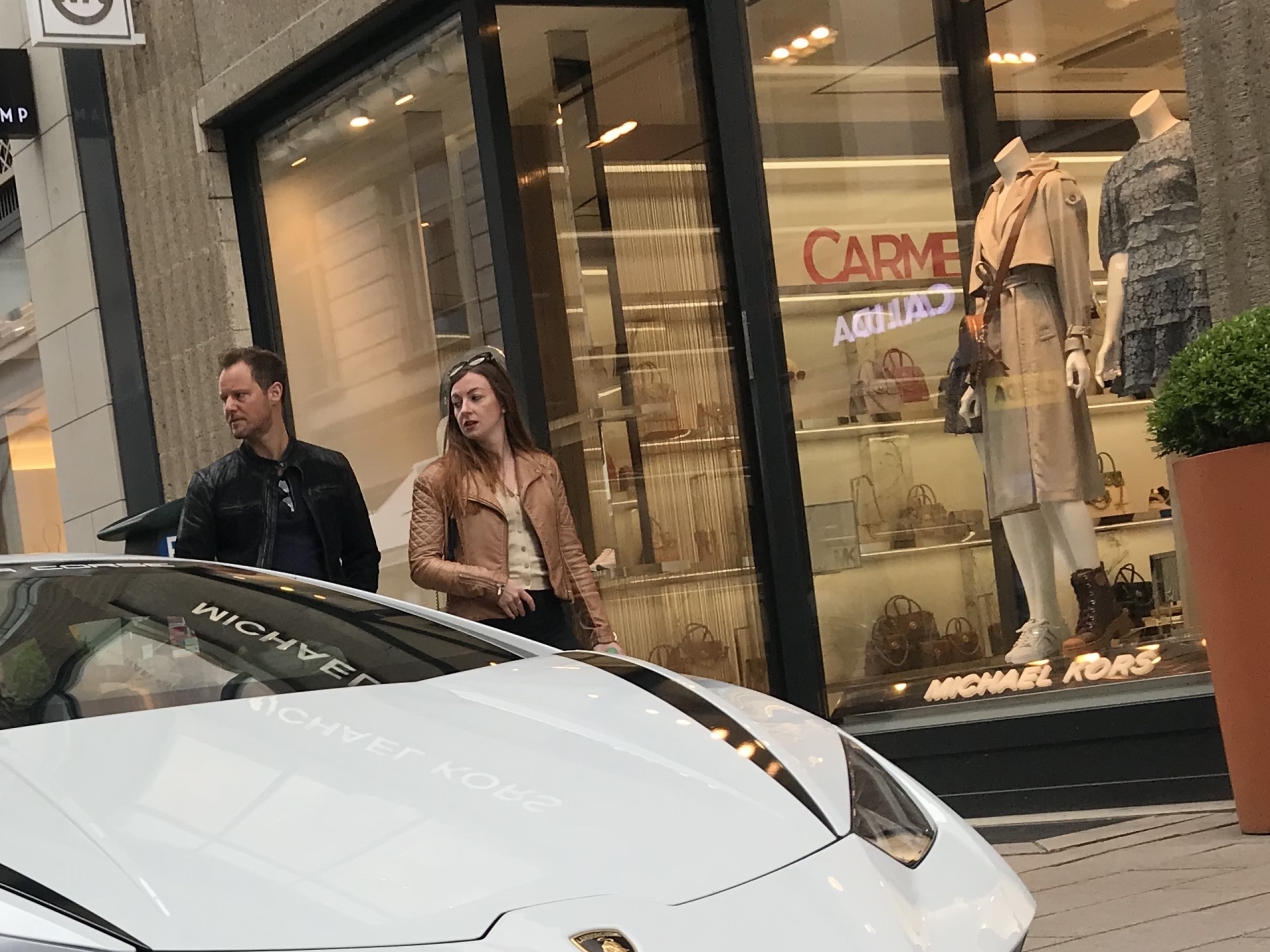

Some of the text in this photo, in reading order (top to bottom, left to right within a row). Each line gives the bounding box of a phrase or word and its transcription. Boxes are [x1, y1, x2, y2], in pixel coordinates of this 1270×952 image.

[31, 561, 175, 571] CORSE
[923, 651, 1160, 702] MICHAEL KORS
